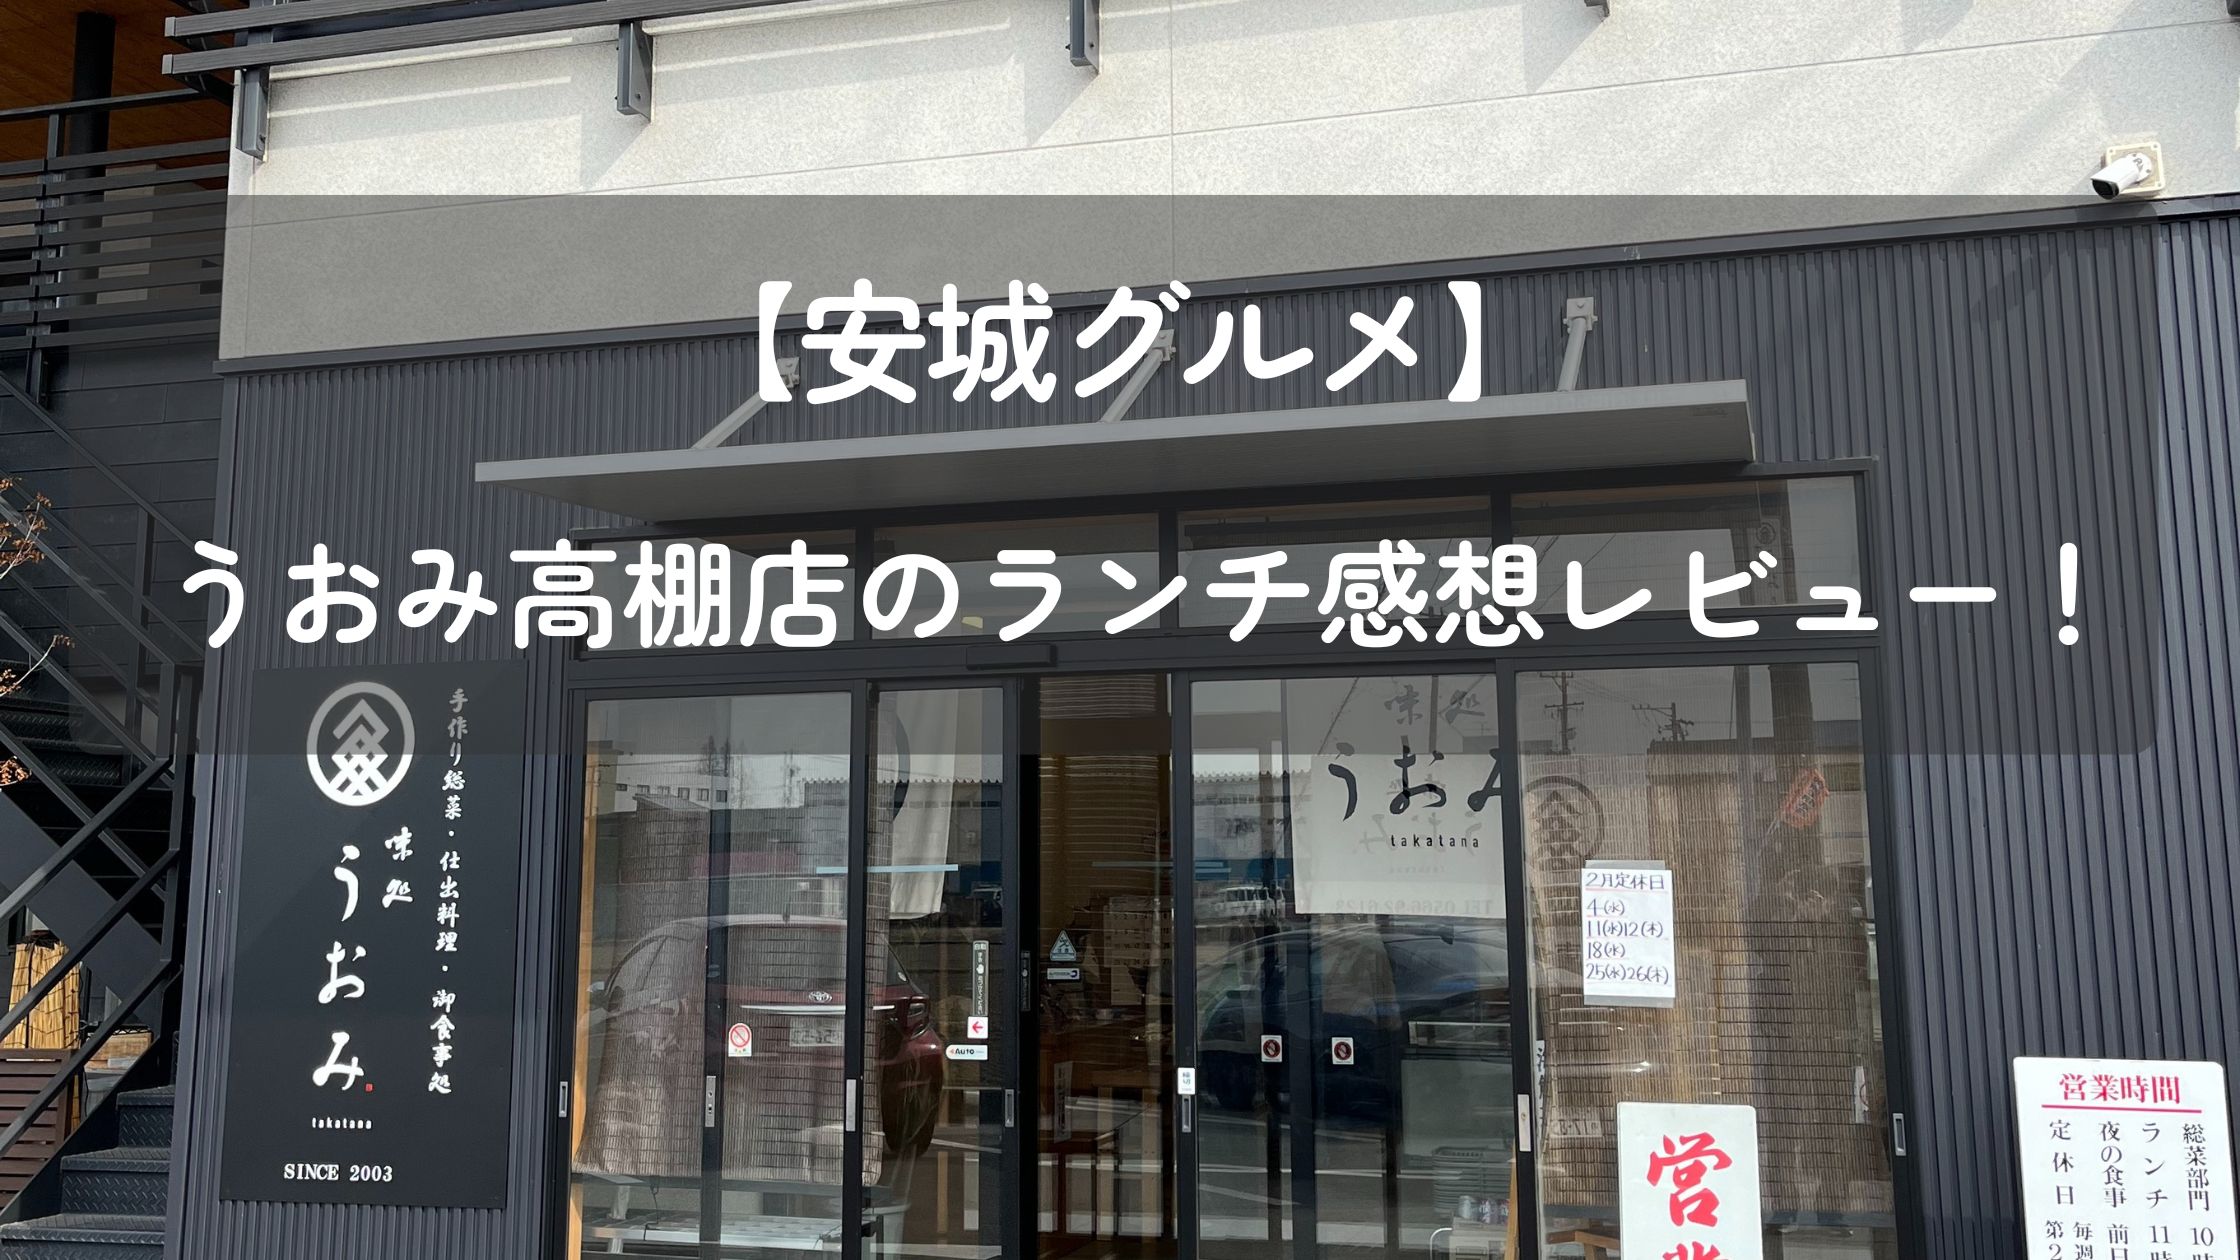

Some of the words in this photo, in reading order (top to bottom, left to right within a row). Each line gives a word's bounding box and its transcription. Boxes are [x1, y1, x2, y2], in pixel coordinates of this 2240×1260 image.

[382, 827, 413, 908] 味処
[1390, 834, 1479, 849] takatana
[1585, 872, 1665, 891] 2月定休日
[313, 845, 366, 1090] うおみ
[312, 1117, 371, 1129] takatana
[2059, 1072, 2181, 1105] 営業時間
[284, 1164, 339, 1180] SINCE
[350, 1165, 392, 1182] 2003
[1646, 1131, 1734, 1260] 営
[2049, 1119, 2075, 1205] 定休日
[2098, 1120, 2127, 1209] 夜の食事
[2141, 1122, 2169, 1209] ランチ
[2182, 1122, 2211, 1211] 総菜部門
